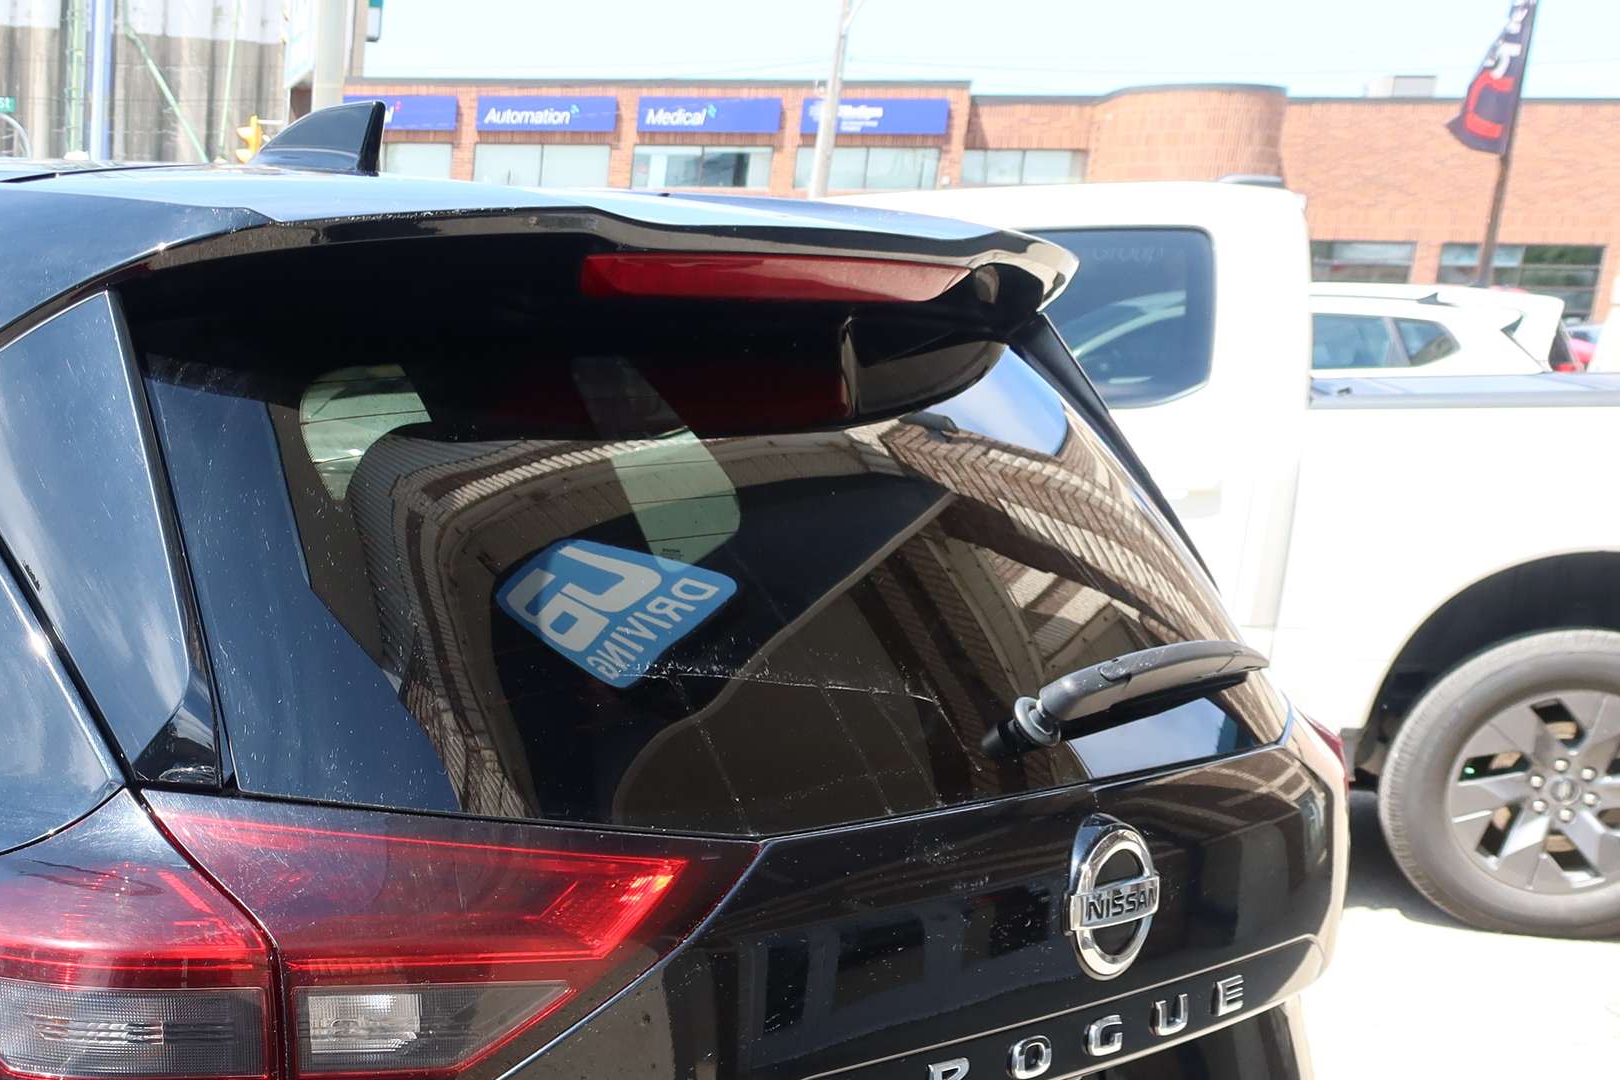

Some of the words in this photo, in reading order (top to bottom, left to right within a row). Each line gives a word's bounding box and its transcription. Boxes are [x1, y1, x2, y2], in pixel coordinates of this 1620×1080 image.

[484, 107, 571, 125] Automation
[645, 107, 707, 126] Medical
[1086, 887, 1157, 921] NISSAN
